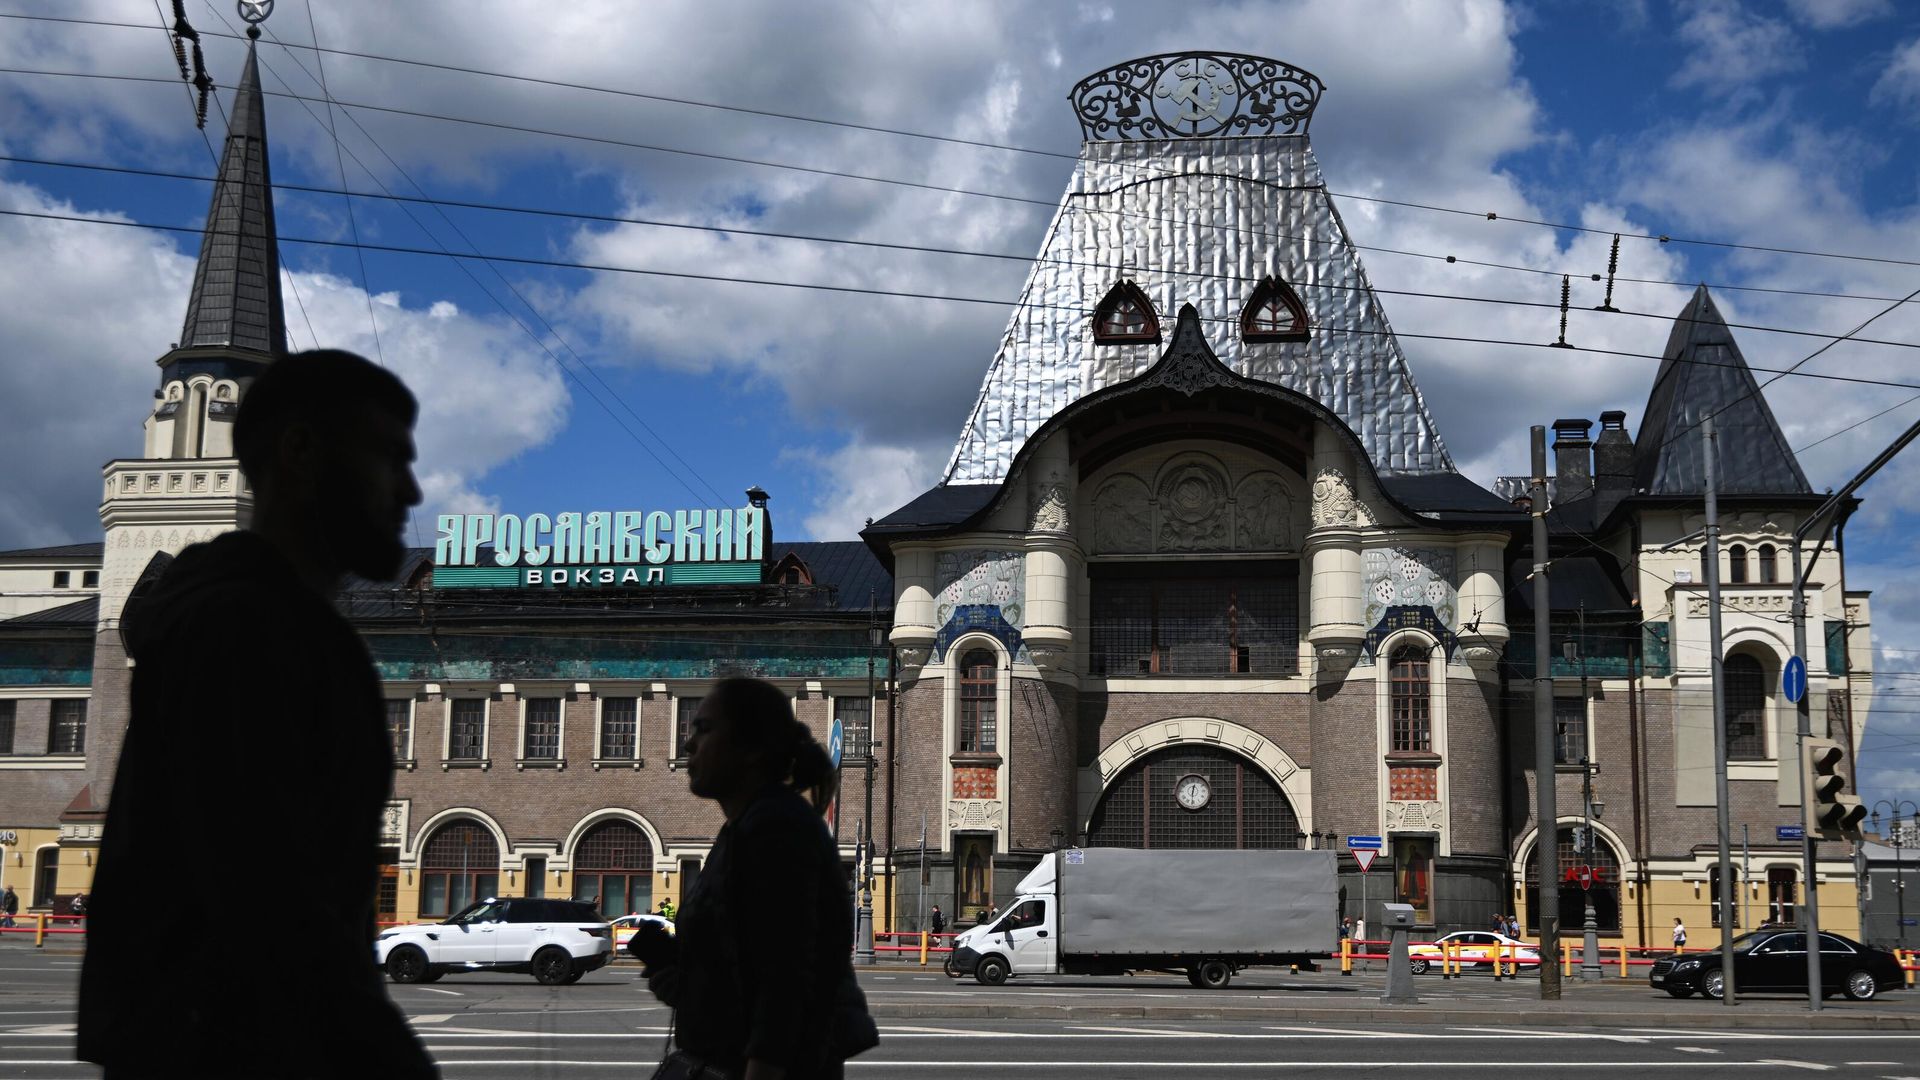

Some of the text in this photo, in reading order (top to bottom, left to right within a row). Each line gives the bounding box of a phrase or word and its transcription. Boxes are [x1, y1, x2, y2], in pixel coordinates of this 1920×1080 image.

[435, 504, 764, 567] ЯРОСЛАВСКИЙ
[527, 567, 665, 585] ВОКЗАЛ
[1566, 867, 1605, 881] KC
